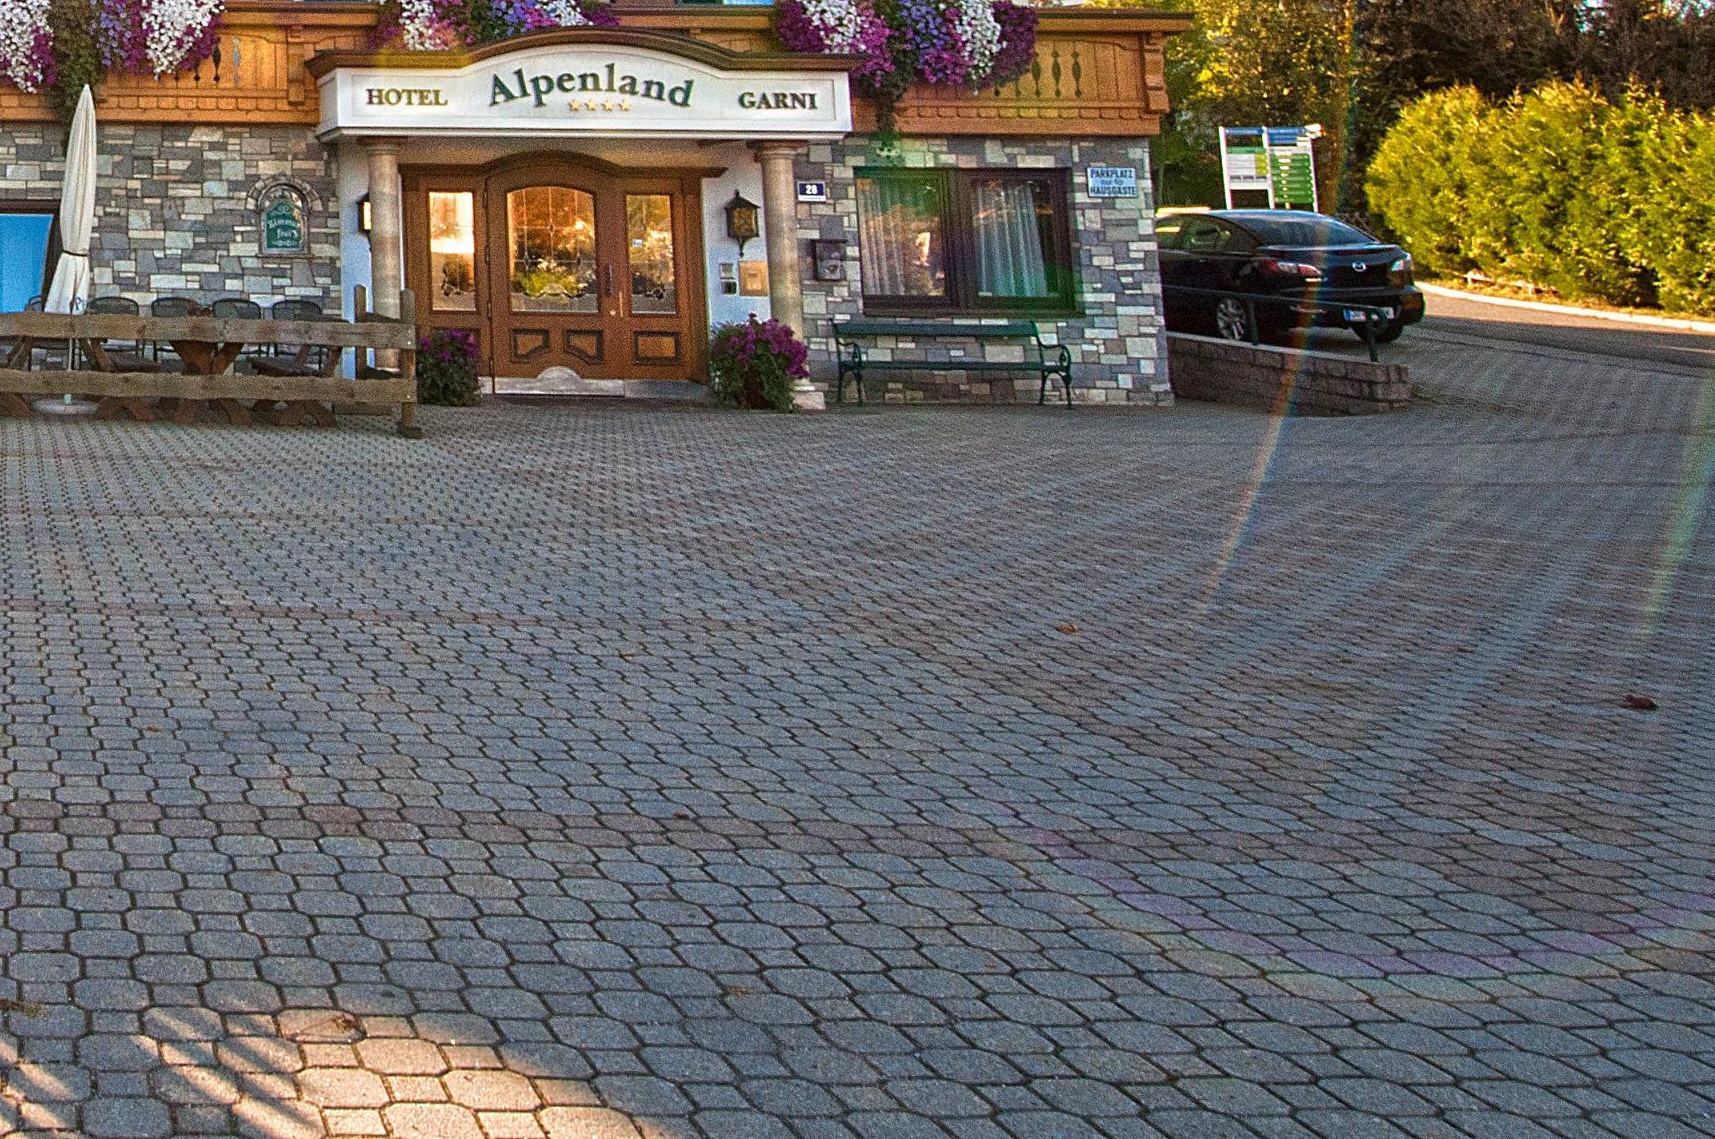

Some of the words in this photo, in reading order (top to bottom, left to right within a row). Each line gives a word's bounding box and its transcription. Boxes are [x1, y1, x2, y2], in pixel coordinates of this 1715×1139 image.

[366, 88, 449, 106] HOTEL
[488, 63, 695, 108] Alpenland
[737, 91, 819, 110] GARNI
[1090, 168, 1134, 179] PARKPLATZ
